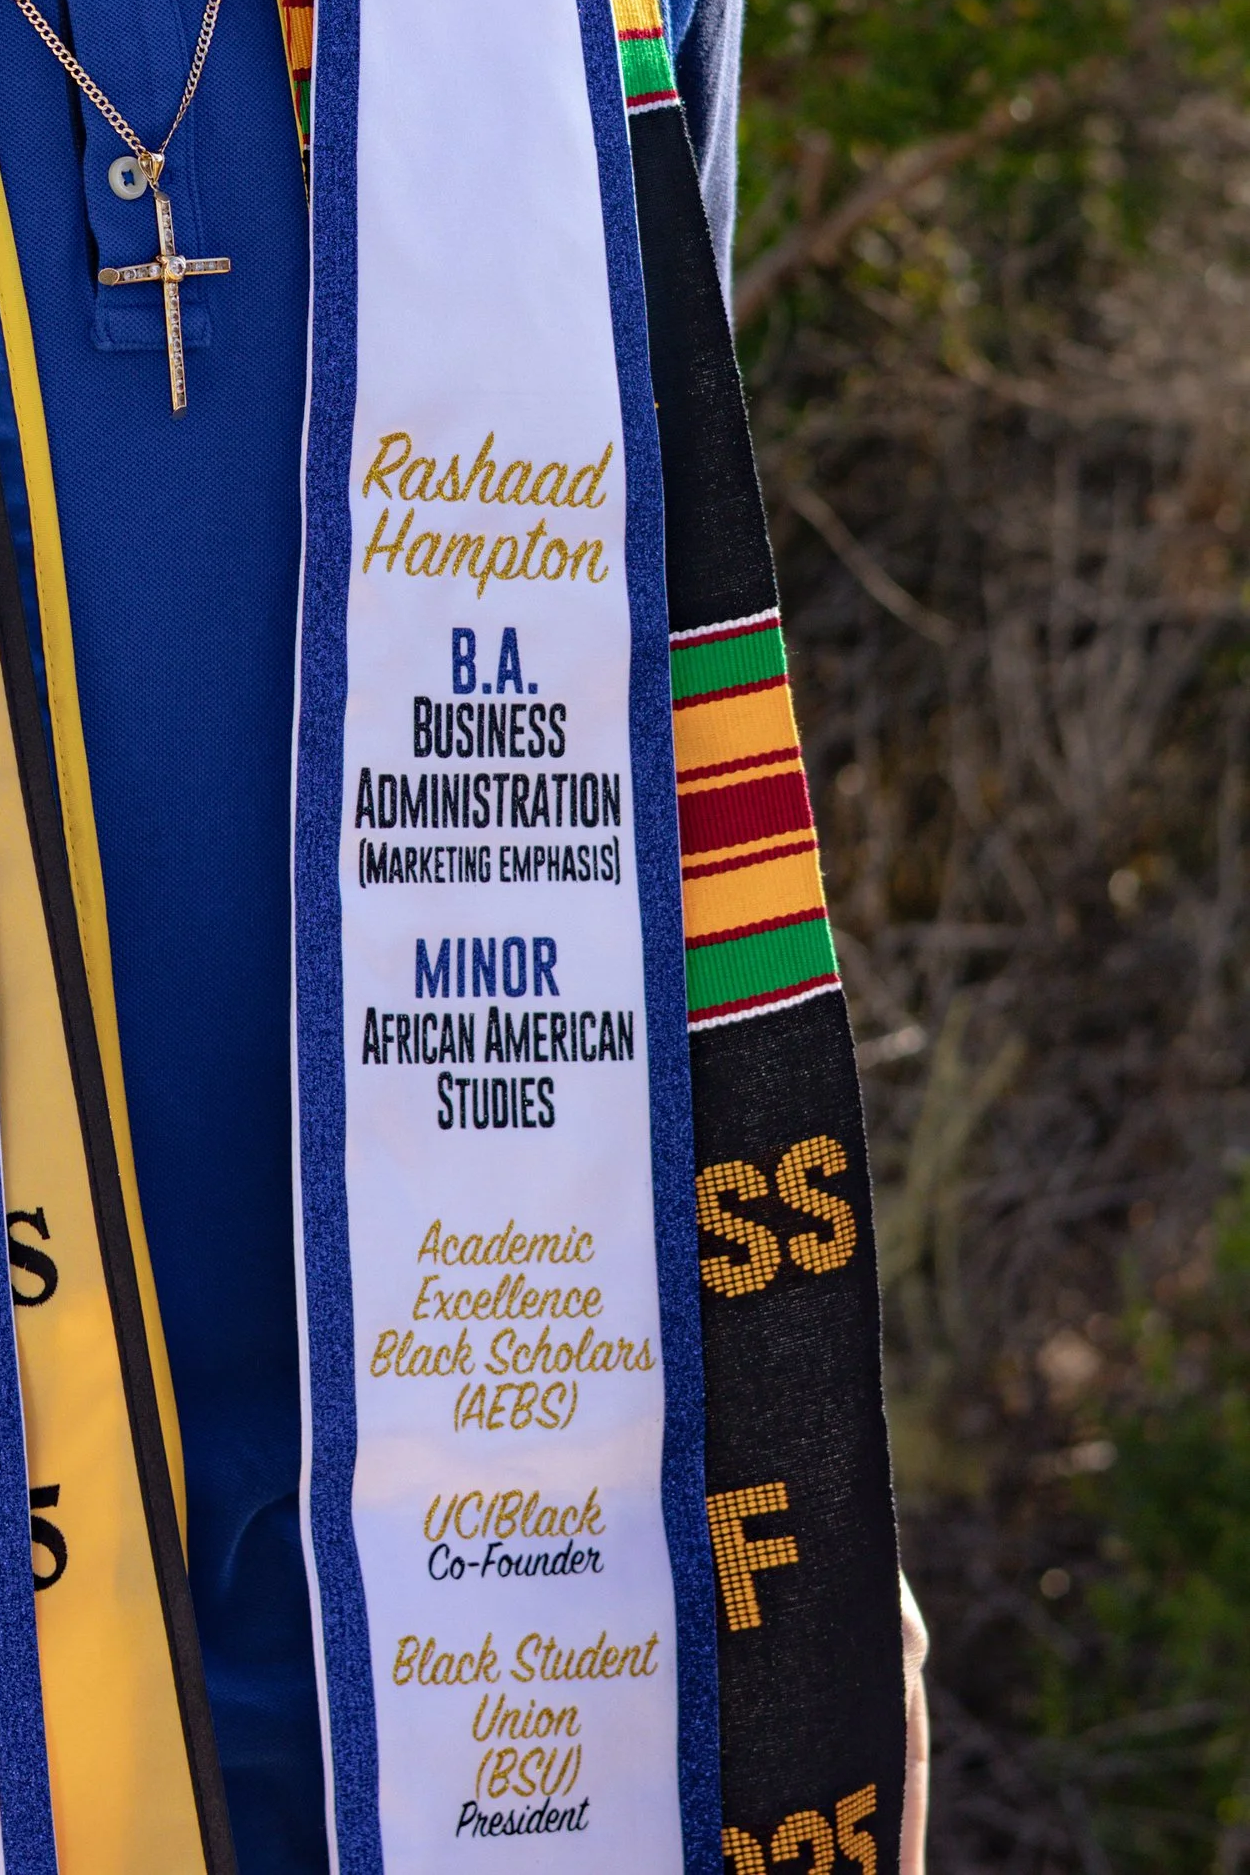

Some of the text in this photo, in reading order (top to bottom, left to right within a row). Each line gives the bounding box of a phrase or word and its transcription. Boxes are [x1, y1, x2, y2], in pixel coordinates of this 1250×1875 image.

[362, 431, 613, 509] Rashaad
[362, 507, 609, 600] Hampton
[452, 627, 538, 695] B.A.
[413, 696, 567, 759] BUSINESS
[354, 767, 621, 829] ADMINISTRATION
[415, 937, 560, 999] MINOR
[362, 1006, 634, 1065] AFRICAN AMERICAN
[437, 1071, 555, 1130] STUDIES
[417, 1218, 595, 1266] Academic
[413, 1273, 604, 1321] Excellence
[370, 1324, 656, 1378] Black Scholars
[454, 1380, 578, 1433] (AEBS)
[428, 1539, 604, 1580] Co-Founder
[392, 1630, 660, 1686] Black Student
[472, 1693, 582, 1743] Union
[476, 1743, 582, 1801] (BSU)
[455, 1796, 590, 1839] President
